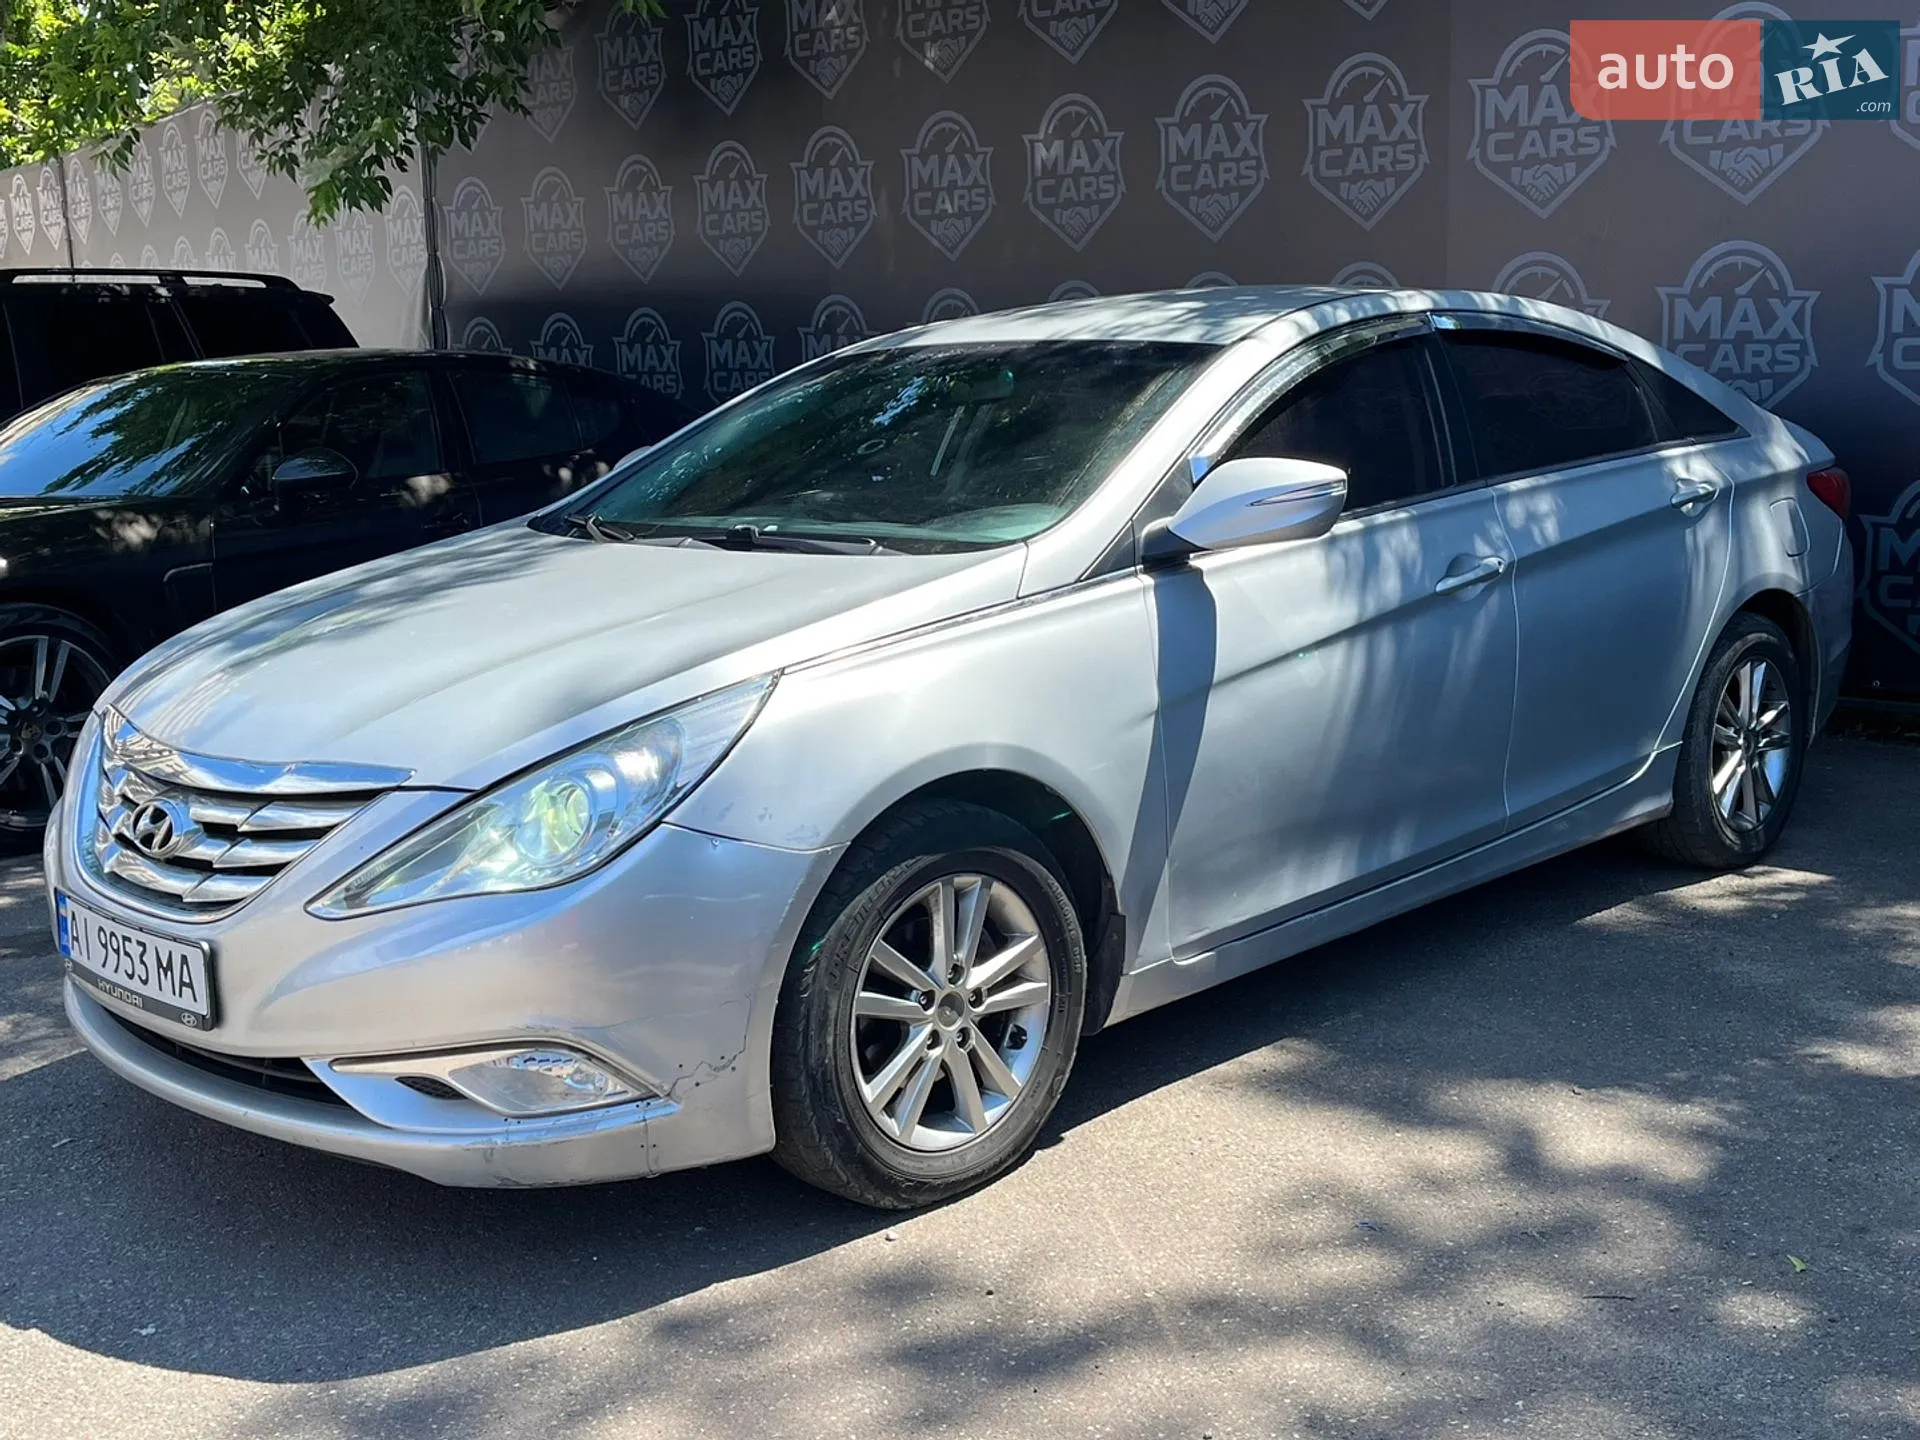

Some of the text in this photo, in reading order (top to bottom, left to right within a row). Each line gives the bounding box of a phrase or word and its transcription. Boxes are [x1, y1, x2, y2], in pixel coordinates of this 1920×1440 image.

[790, 0, 862, 30] MAX
[908, 7, 981, 38] CARS
[692, 15, 752, 48] MAX
[795, 27, 861, 57] CARS
[604, 35, 656, 66] MAX
[696, 47, 755, 75] CARS
[606, 66, 659, 92] CARS
[1317, 103, 1417, 146] MAX
[200, 135, 225, 159] MAX
[1168, 122, 1257, 161] MAX
[1486, 130, 1601, 162] CARS
[162, 150, 186, 174] MAX
[201, 156, 226, 178] CARS
[911, 154, 987, 188] MAX
[1034, 138, 1116, 177] MAX
[1318, 144, 1416, 177] CARS
[165, 172, 188, 191] CARS
[801, 167, 868, 200] MAX
[1036, 175, 1115, 204] CARS
[1170, 161, 1257, 192] CARS
[612, 192, 669, 222] MAX
[702, 180, 762, 211] MAX
[913, 190, 986, 216] CARS
[451, 211, 500, 238] MAX
[529, 203, 581, 231] MAX
[705, 210, 764, 235] CARS
[803, 201, 868, 226] CARS
[339, 229, 371, 252] MAX
[389, 217, 424, 245] MAX
[532, 231, 582, 254] CARS
[616, 221, 669, 245] CARS
[453, 238, 499, 260] CARS
[1672, 298, 1804, 340] MAX
[620, 344, 676, 372] MAX
[711, 338, 768, 369] MAX
[97, 926, 149, 986] 9953
[155, 945, 198, 1003] MA
